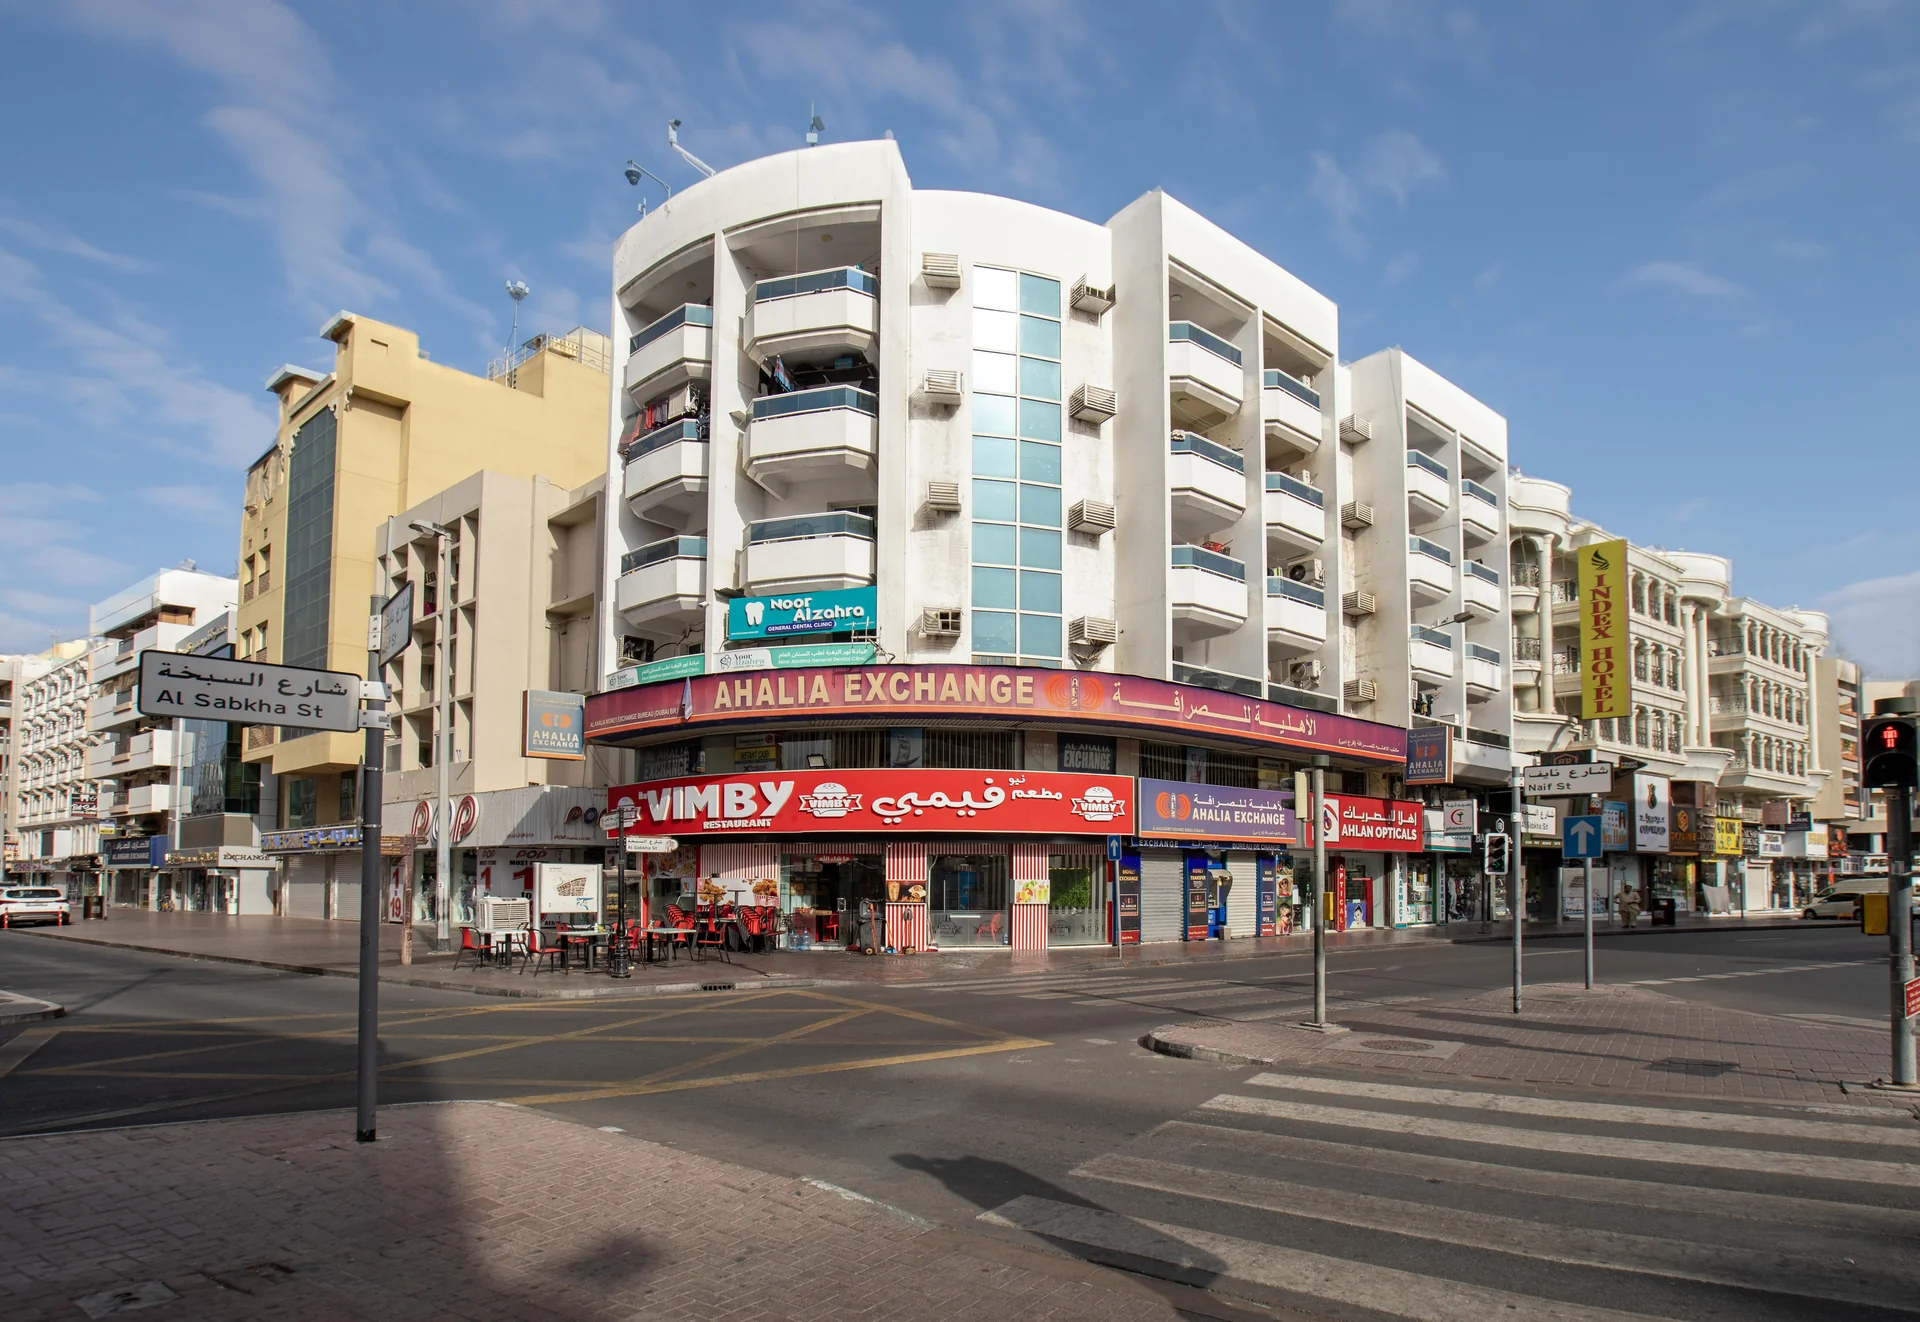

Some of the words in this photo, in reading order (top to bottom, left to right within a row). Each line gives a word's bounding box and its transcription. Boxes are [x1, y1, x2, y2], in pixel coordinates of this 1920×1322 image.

[770, 597, 812, 610] Noor
[1589, 573, 1614, 640] INDEX
[793, 605, 864, 622] Alzahra
[158, 662, 263, 687] السبخة
[1590, 646, 1614, 713] HOTEL
[278, 679, 348, 698] شارع
[714, 675, 830, 709] AHALIA
[844, 672, 1035, 705] EXCHANGE
[156, 690, 183, 705] Al
[194, 694, 286, 714] Sabkha
[297, 704, 323, 718] St
[1112, 682, 1251, 723] للصرافة
[618, 713, 637, 722] EXCHANGE
[1254, 704, 1316, 736] الأهلية
[532, 739, 579, 748] EXCHANGE
[533, 730, 579, 742] AHALIA
[1079, 744, 1110, 752] AHALIA
[644, 758, 689, 779] EXCHANGE
[1064, 750, 1110, 770] EXCHANGE
[1409, 760, 1443, 769] AHALIA
[1008, 774, 1026, 786] نيو
[1529, 768, 1560, 779] نايف
[1569, 766, 1608, 778] شارع
[1528, 783, 1552, 792] Naif
[647, 781, 794, 821] VIMBY
[809, 799, 852, 808] VIMBY
[872, 777, 1006, 824] فيمبي
[1011, 788, 1063, 800] مطعم
[1080, 802, 1116, 812] VIMBY
[703, 819, 772, 829] RESTAURANT
[1192, 808, 1231, 822] AHALIA
[1234, 811, 1285, 826] EXCHANGE
[1342, 824, 1373, 838] AHLAN
[1376, 826, 1417, 840] OPTICALS
[223, 853, 270, 862] EXCHANGE
[516, 850, 547, 858] POP
[392, 868, 399, 889] 1
[480, 866, 491, 891] 1
[390, 897, 401, 918] 19
